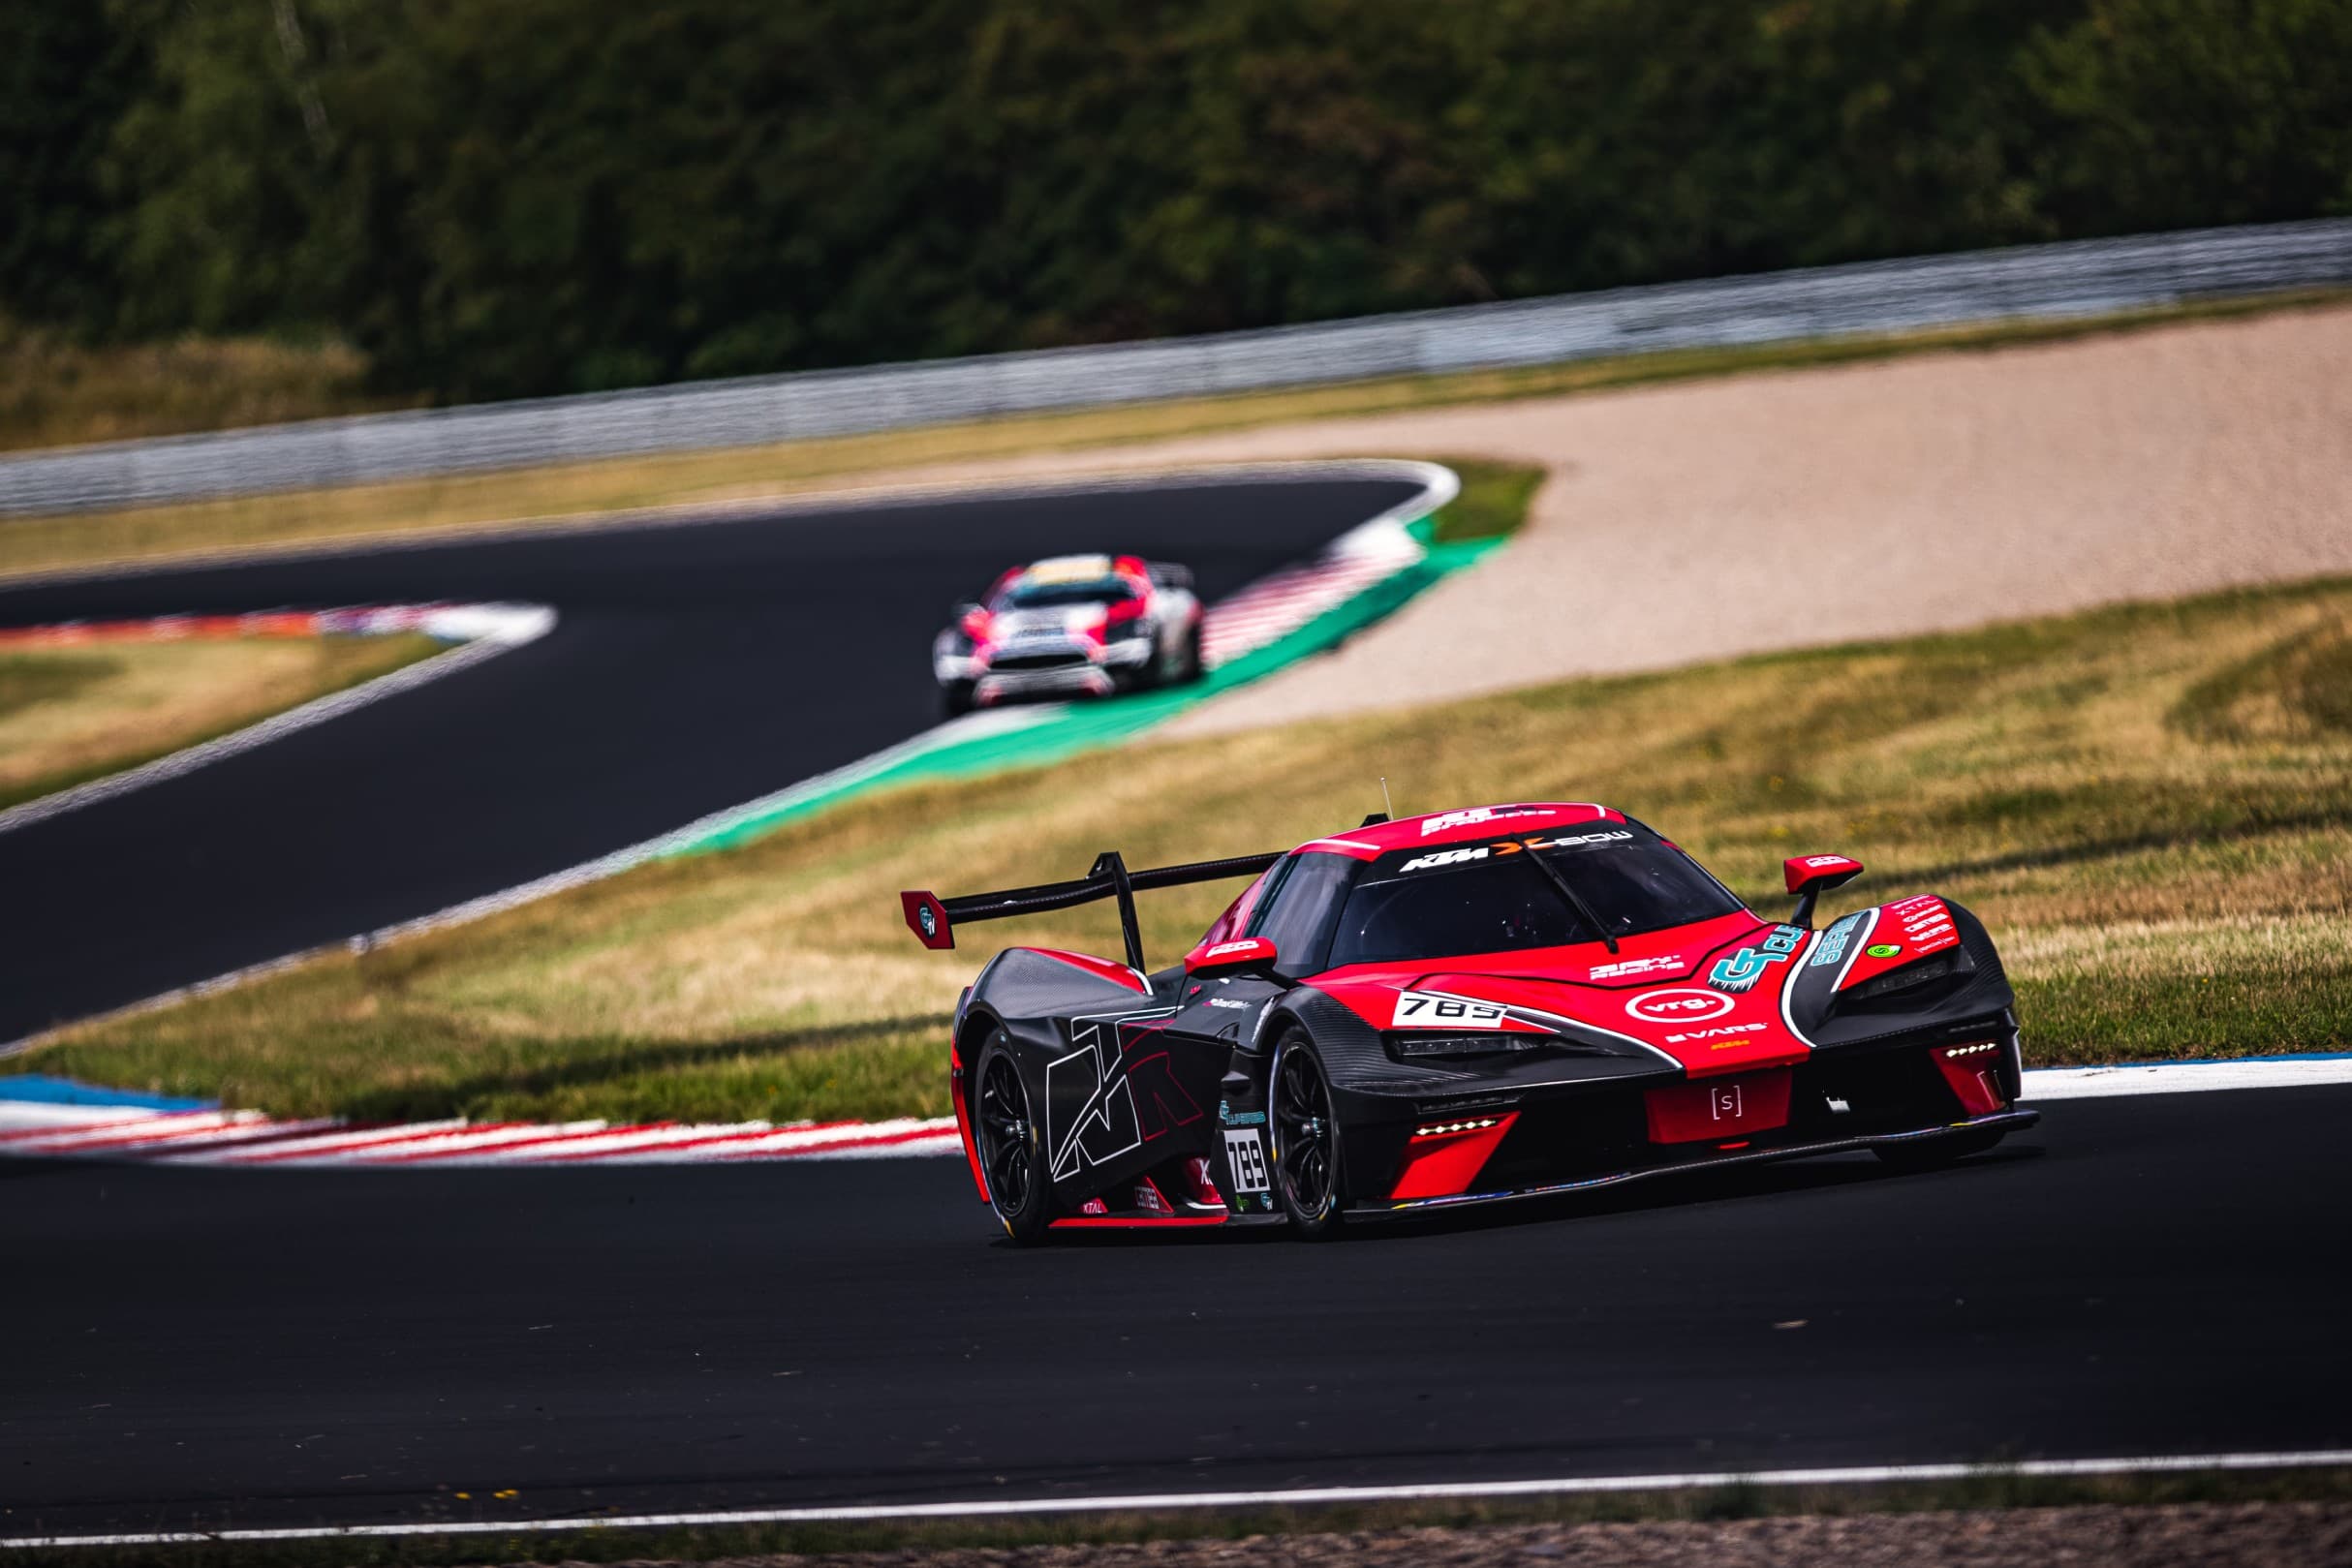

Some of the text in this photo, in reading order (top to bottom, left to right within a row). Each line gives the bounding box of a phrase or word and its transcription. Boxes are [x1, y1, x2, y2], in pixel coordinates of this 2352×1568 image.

[1400, 847, 1489, 873] KTM
[1402, 998, 1501, 1020] 789
[1227, 1140, 1268, 1190] 789
